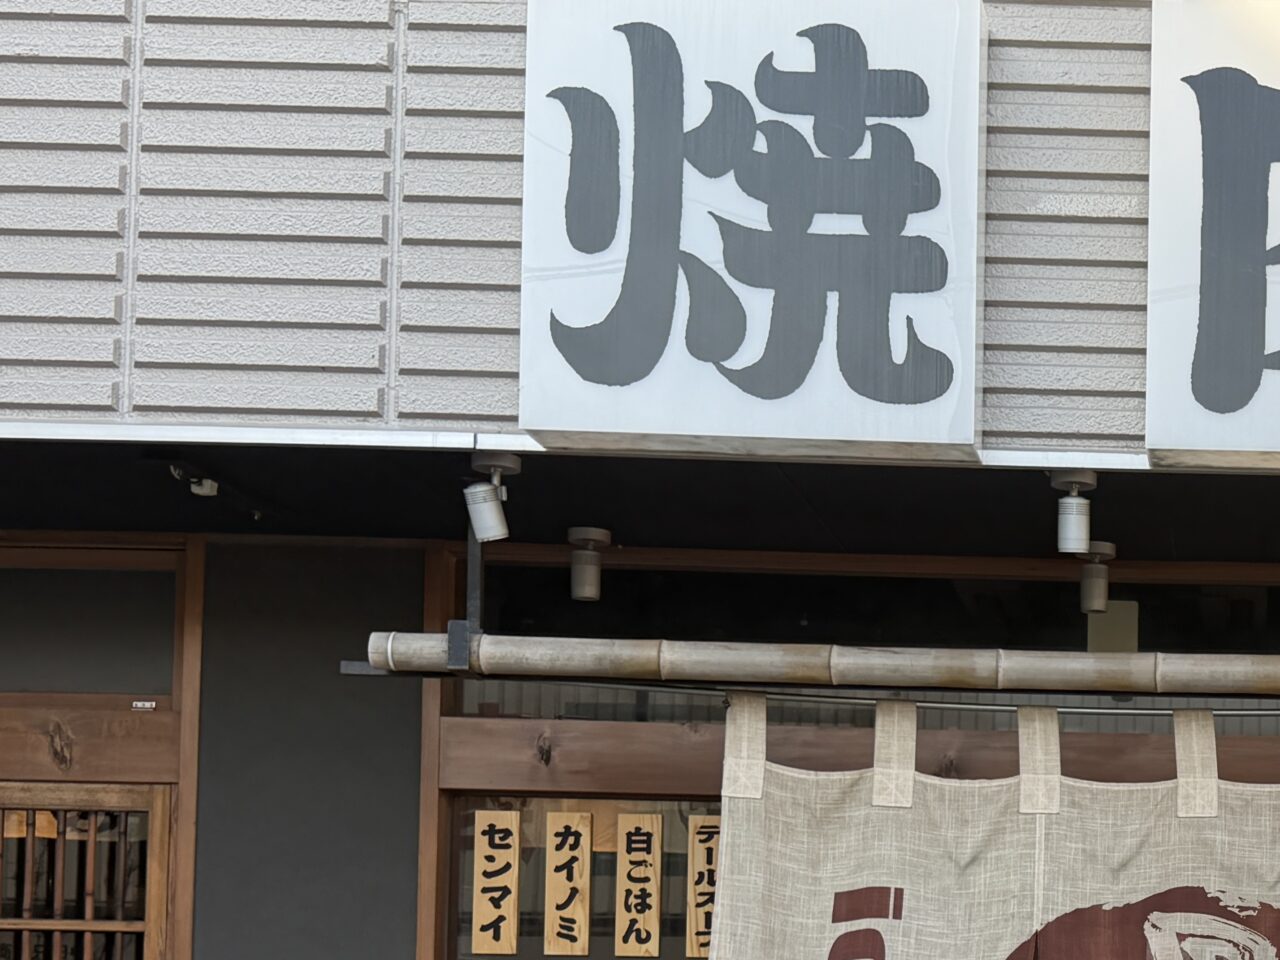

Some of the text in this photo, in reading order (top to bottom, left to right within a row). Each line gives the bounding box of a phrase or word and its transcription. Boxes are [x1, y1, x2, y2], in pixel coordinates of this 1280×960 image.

[480, 823, 513, 942] センマイ
[554, 825, 582, 943] カイノミ
[622, 827, 653, 944] 白ごはん
